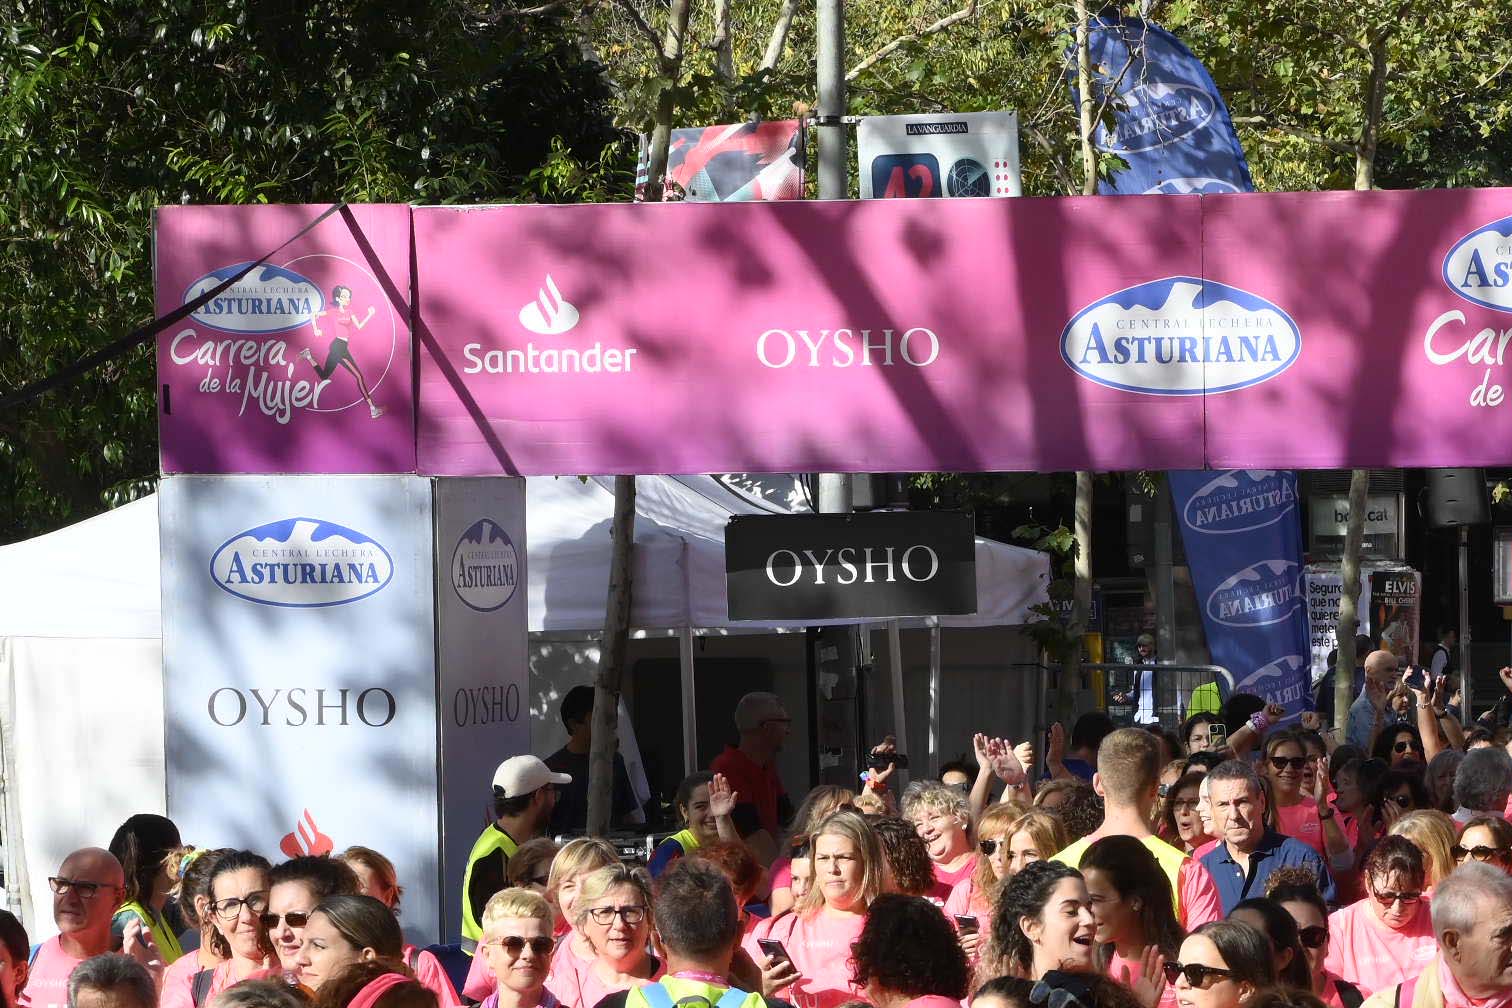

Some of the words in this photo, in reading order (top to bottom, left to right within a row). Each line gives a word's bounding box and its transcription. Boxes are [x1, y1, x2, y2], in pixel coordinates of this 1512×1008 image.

[919, 122, 968, 134] VANGUARDIA
[1116, 317, 1194, 330] CENTRAL
[1199, 316, 1274, 329] LECHERA
[170, 329, 287, 366] Carrera
[463, 342, 637, 375] Santander
[756, 326, 940, 368] OYSHO
[1080, 321, 1282, 365] ASTURIANA
[200, 368, 221, 393] de
[226, 366, 241, 393] la
[238, 362, 332, 424] Mujer
[1470, 368, 1504, 408] de
[225, 551, 381, 585] ASTURIANA
[252, 548, 311, 558] CENTRAL
[766, 544, 939, 587] OYSHO
[456, 558, 516, 589] ASTURIANA
[1384, 580, 1416, 594] ELVIS
[207, 686, 397, 727] OYSHO
[454, 682, 520, 728] OYSHO
